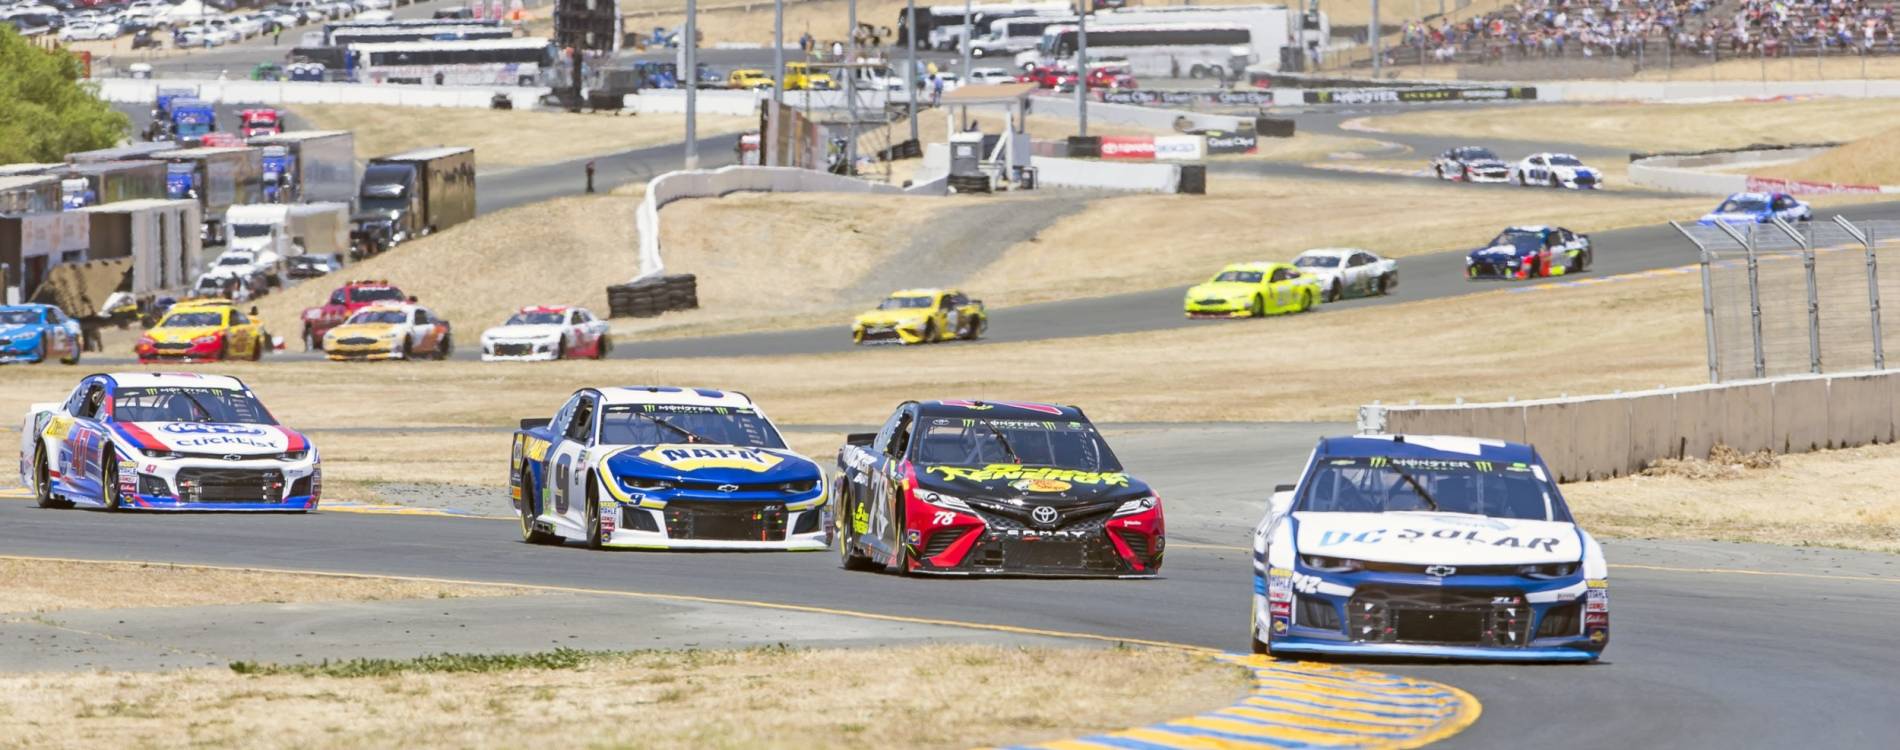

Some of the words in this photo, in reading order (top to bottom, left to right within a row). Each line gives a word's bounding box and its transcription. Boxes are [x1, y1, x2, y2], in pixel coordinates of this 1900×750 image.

[661, 449, 765, 463] NAPA
[1393, 459, 1471, 469] MONSTER
[554, 452, 572, 515] 9
[628, 493, 645, 506] 9
[932, 511, 956, 525] 78
[1318, 529, 1388, 547] DC
[1397, 528, 1561, 553] SOLAR
[1294, 573, 1322, 593] 42
